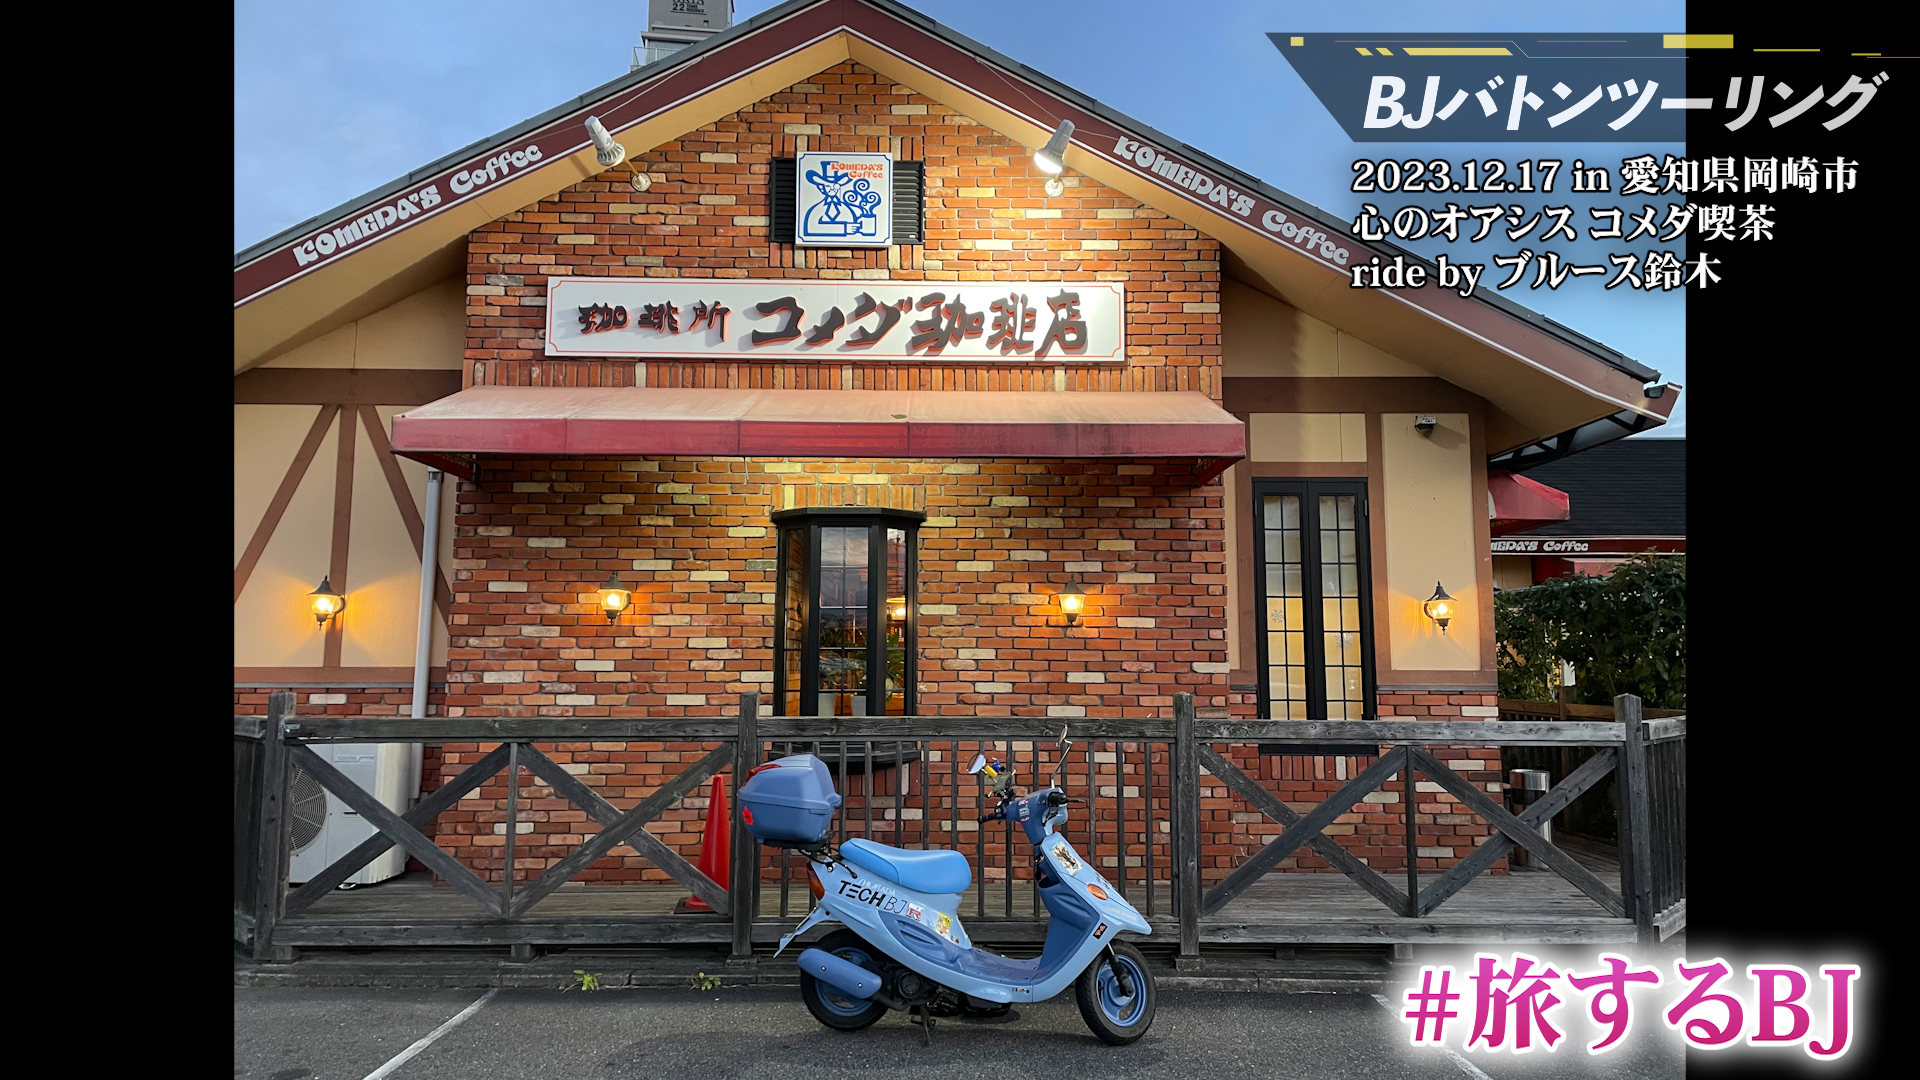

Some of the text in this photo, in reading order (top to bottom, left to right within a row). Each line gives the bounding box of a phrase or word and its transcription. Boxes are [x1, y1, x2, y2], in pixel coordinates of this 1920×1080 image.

[831, 163, 883, 171] KOMEDA'S
[849, 170, 883, 179] Coffee
[292, 145, 543, 266] KOMEDA'S Coffee
[1113, 136, 1350, 265] KOMEDA'S Coffee
[578, 289, 1089, 361] 珈琲所 コメダ珈琲店
[1543, 541, 1589, 551] Coffee
[838, 880, 886, 907] TECH
[884, 896, 908, 914] BJ
